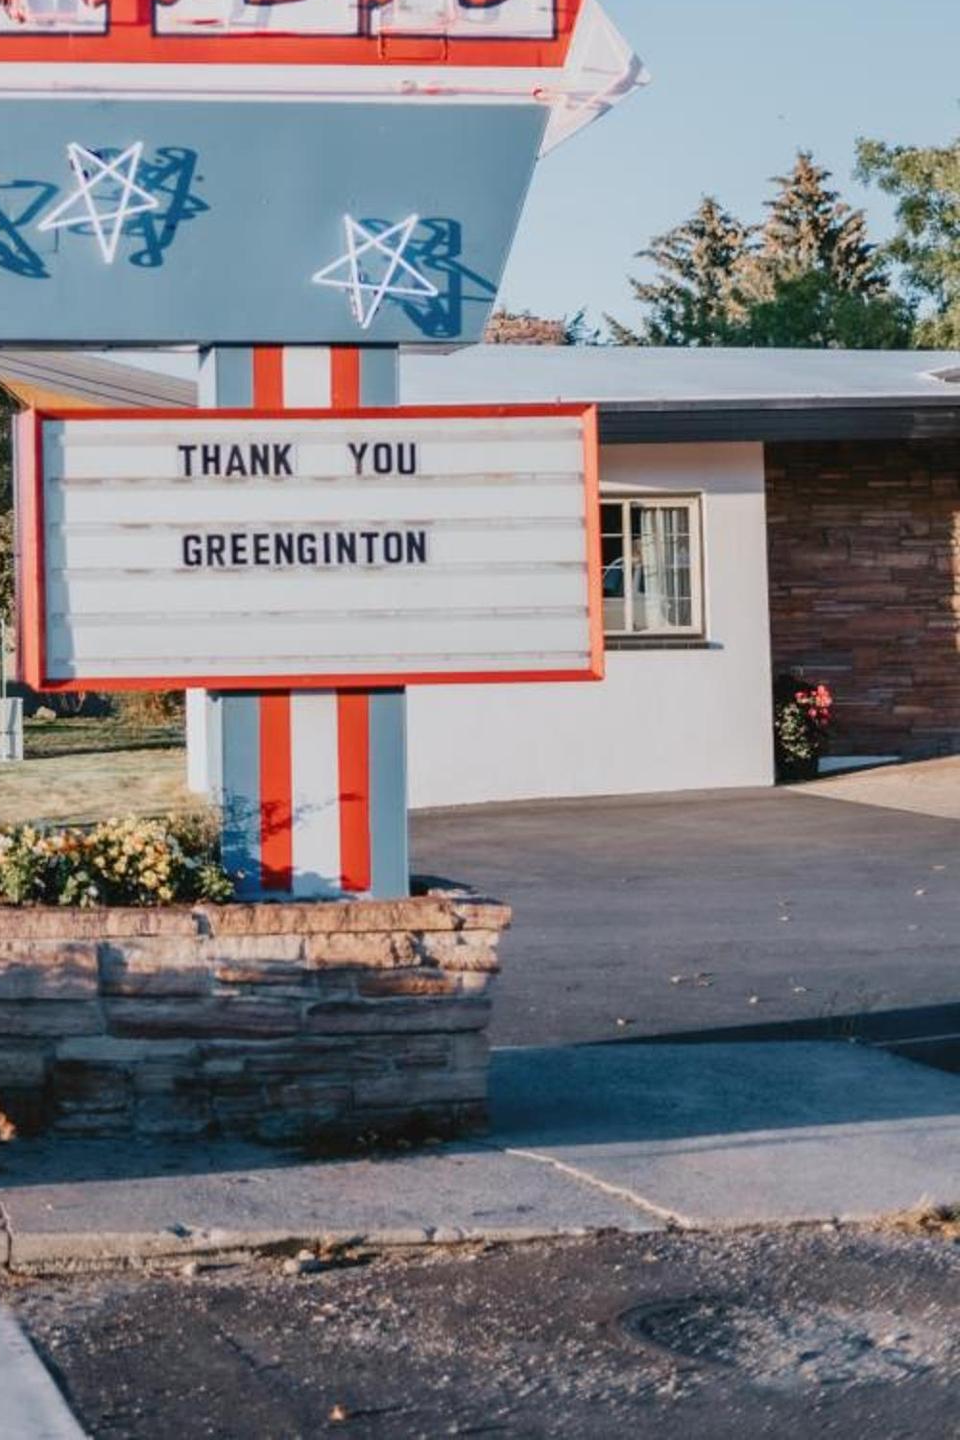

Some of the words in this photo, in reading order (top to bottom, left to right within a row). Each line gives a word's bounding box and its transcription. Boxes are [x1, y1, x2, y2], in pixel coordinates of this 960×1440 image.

[178, 443, 292, 476] THANK
[349, 441, 417, 475] YOU
[182, 531, 427, 567] GREENGINTON
